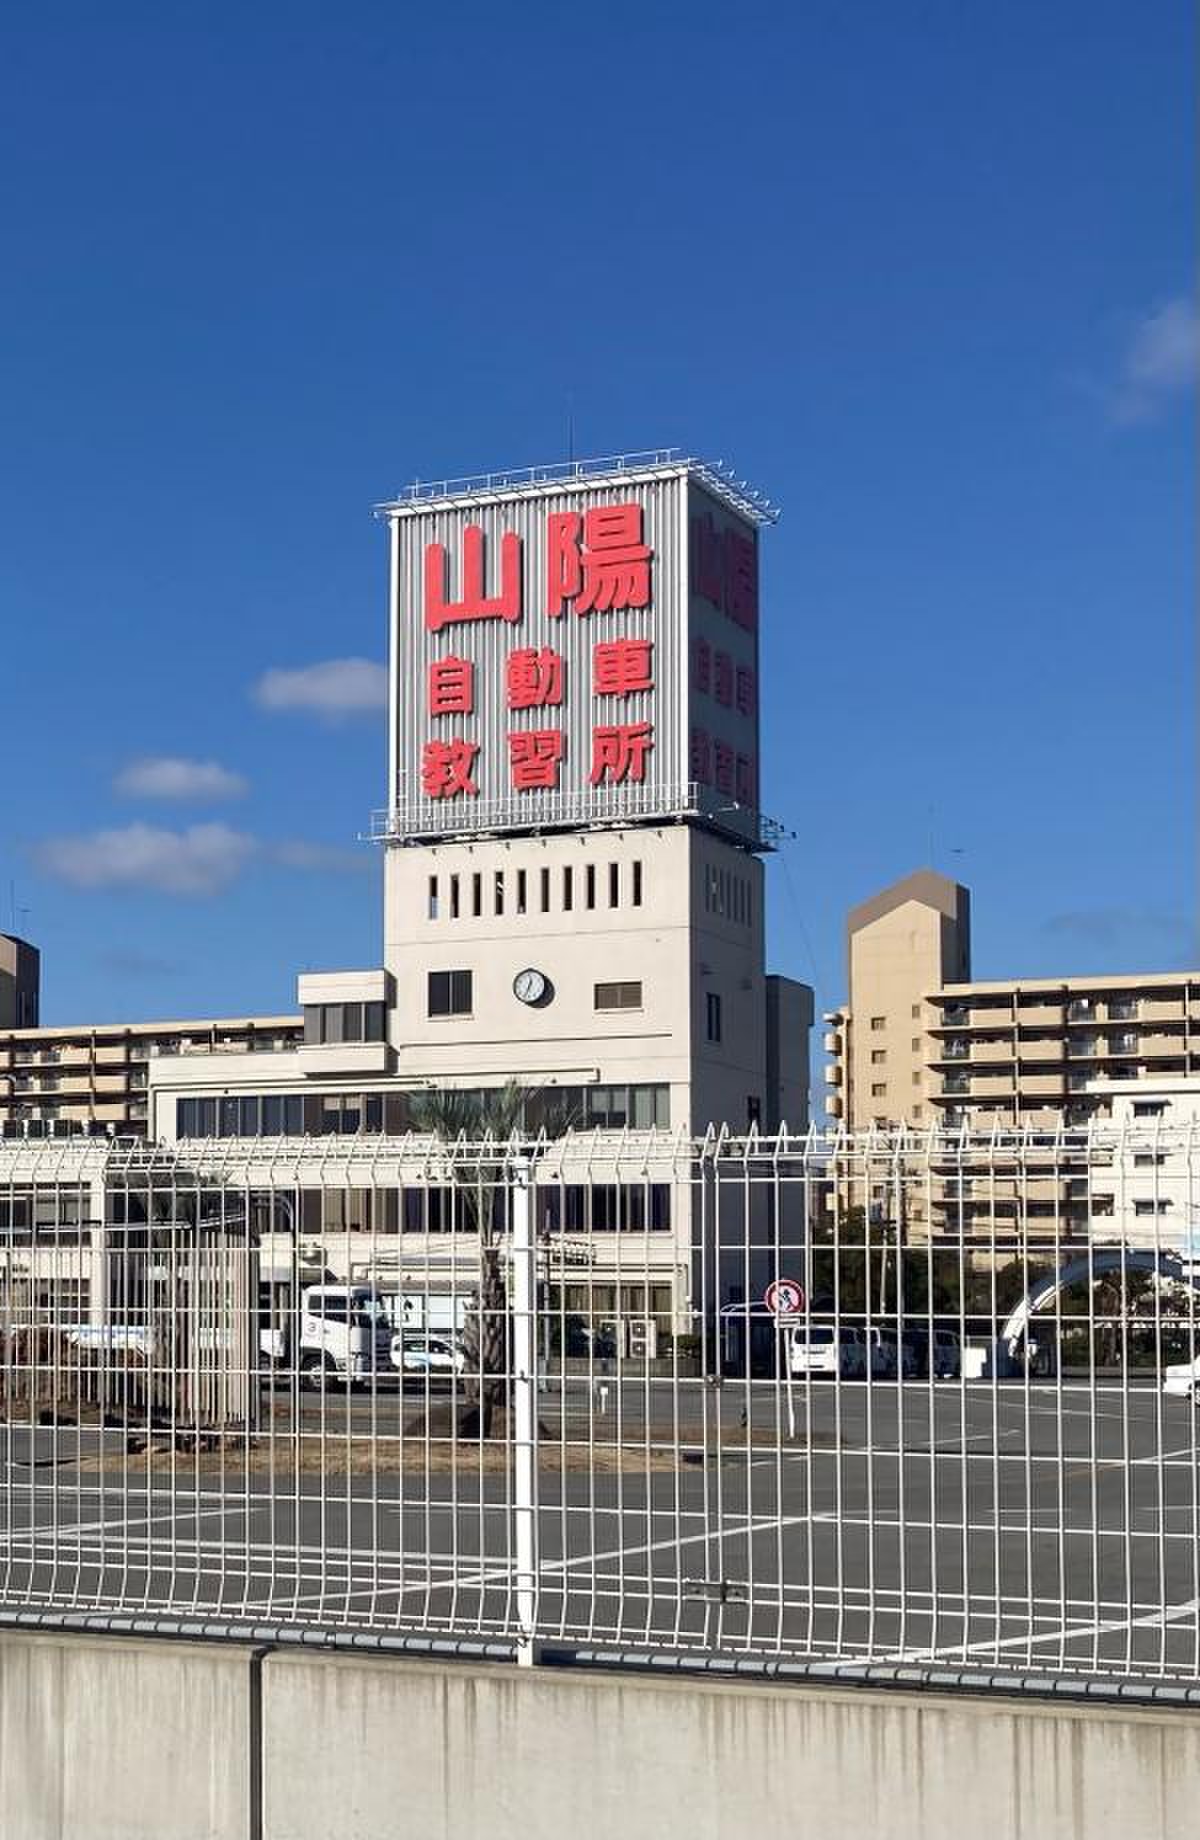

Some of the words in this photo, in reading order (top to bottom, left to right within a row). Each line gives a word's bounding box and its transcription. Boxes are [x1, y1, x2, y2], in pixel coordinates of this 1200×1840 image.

[424, 502, 652, 631] 山陽
[428, 638, 653, 715] 自動車
[421, 721, 652, 799] 教習所
